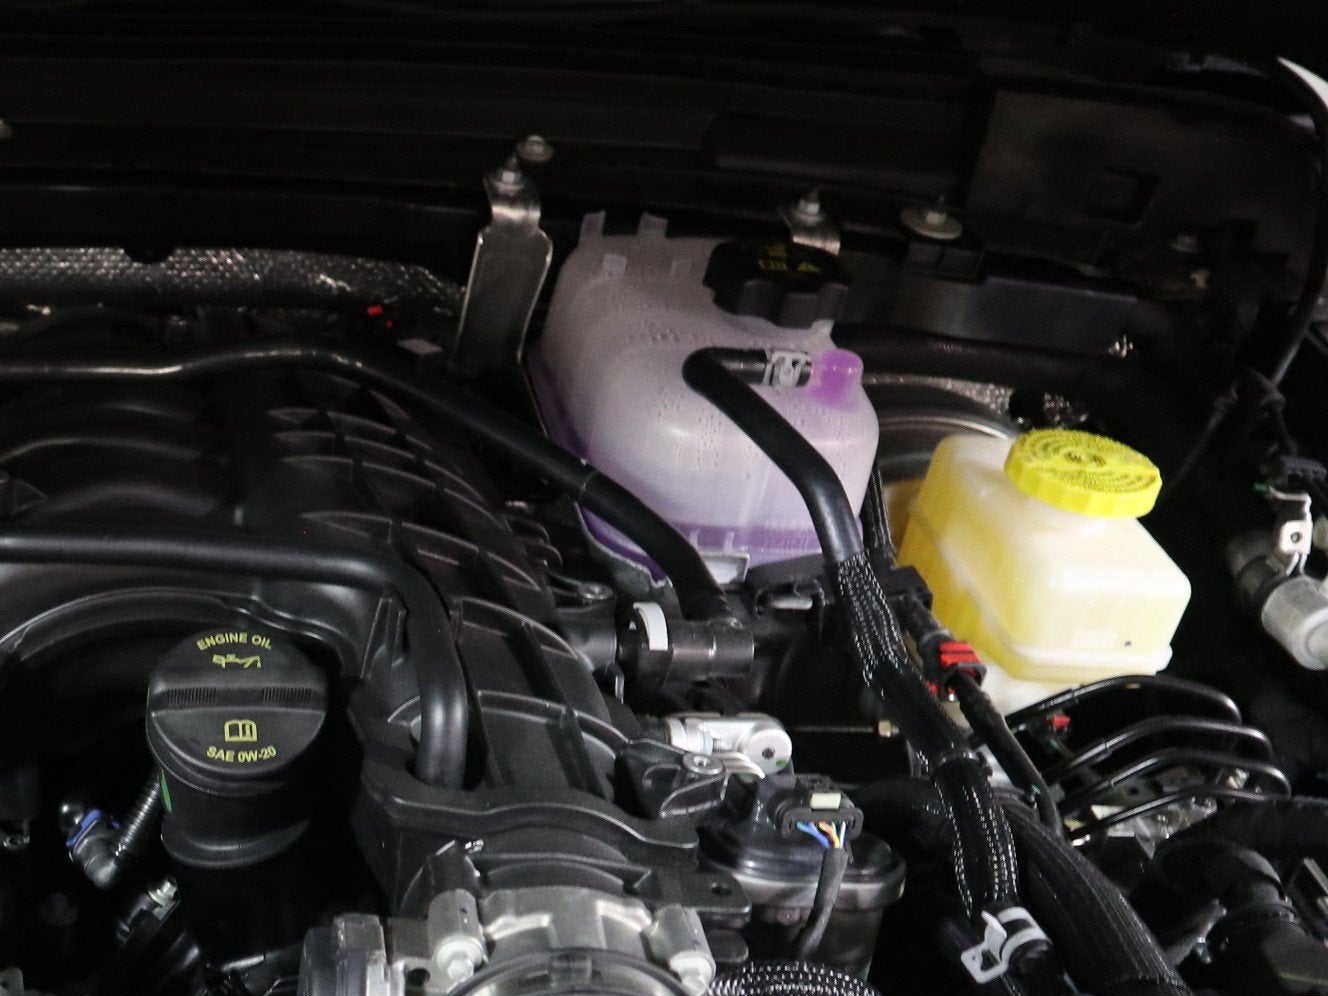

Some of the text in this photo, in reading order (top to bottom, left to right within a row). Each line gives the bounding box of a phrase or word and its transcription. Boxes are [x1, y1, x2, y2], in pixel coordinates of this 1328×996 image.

[196, 632, 272, 651] ENGINE OIL
[206, 744, 276, 763] SAE 0W-20
